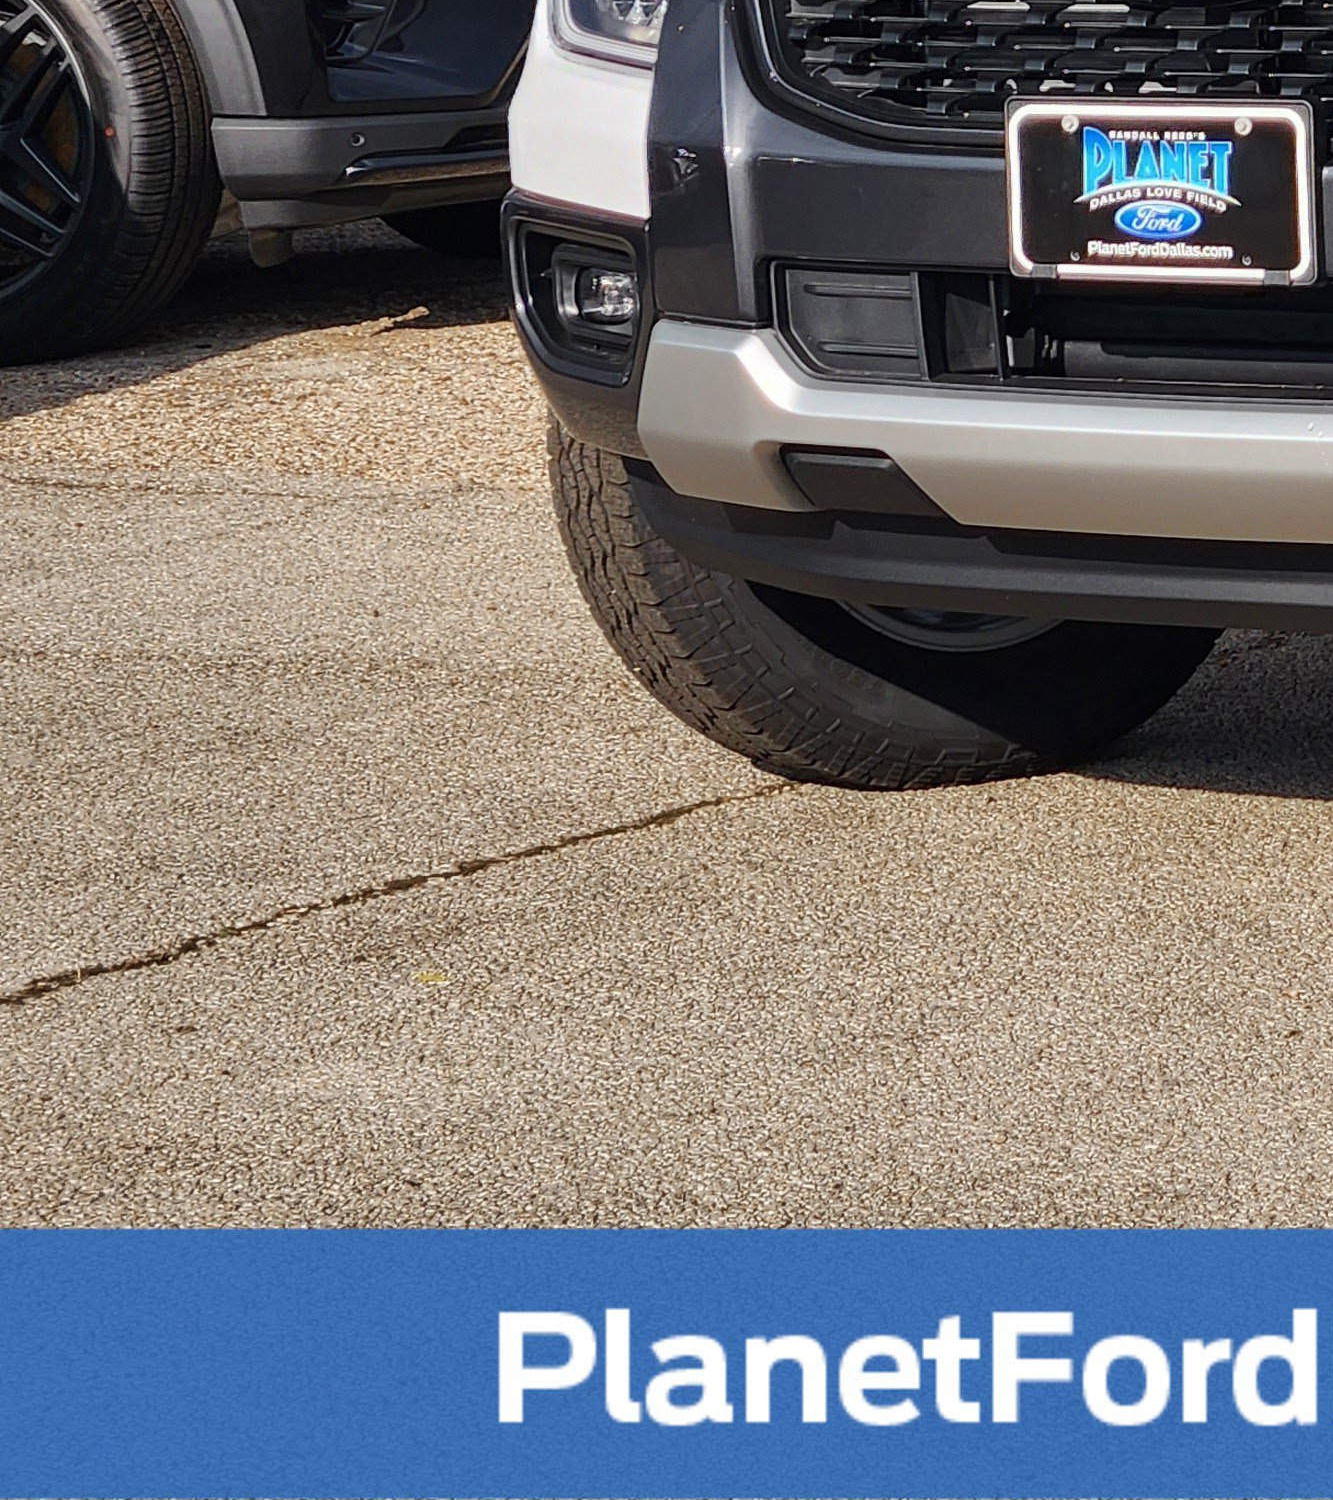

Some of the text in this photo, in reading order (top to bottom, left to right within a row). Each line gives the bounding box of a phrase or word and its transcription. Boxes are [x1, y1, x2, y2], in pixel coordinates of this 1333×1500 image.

[1083, 126, 1233, 197] PLANET
[1089, 187, 1228, 214] DALLAS LOVE FIELD
[1131, 205, 1186, 232] Ford
[1087, 240, 1235, 260] PlanetFordDallas.com
